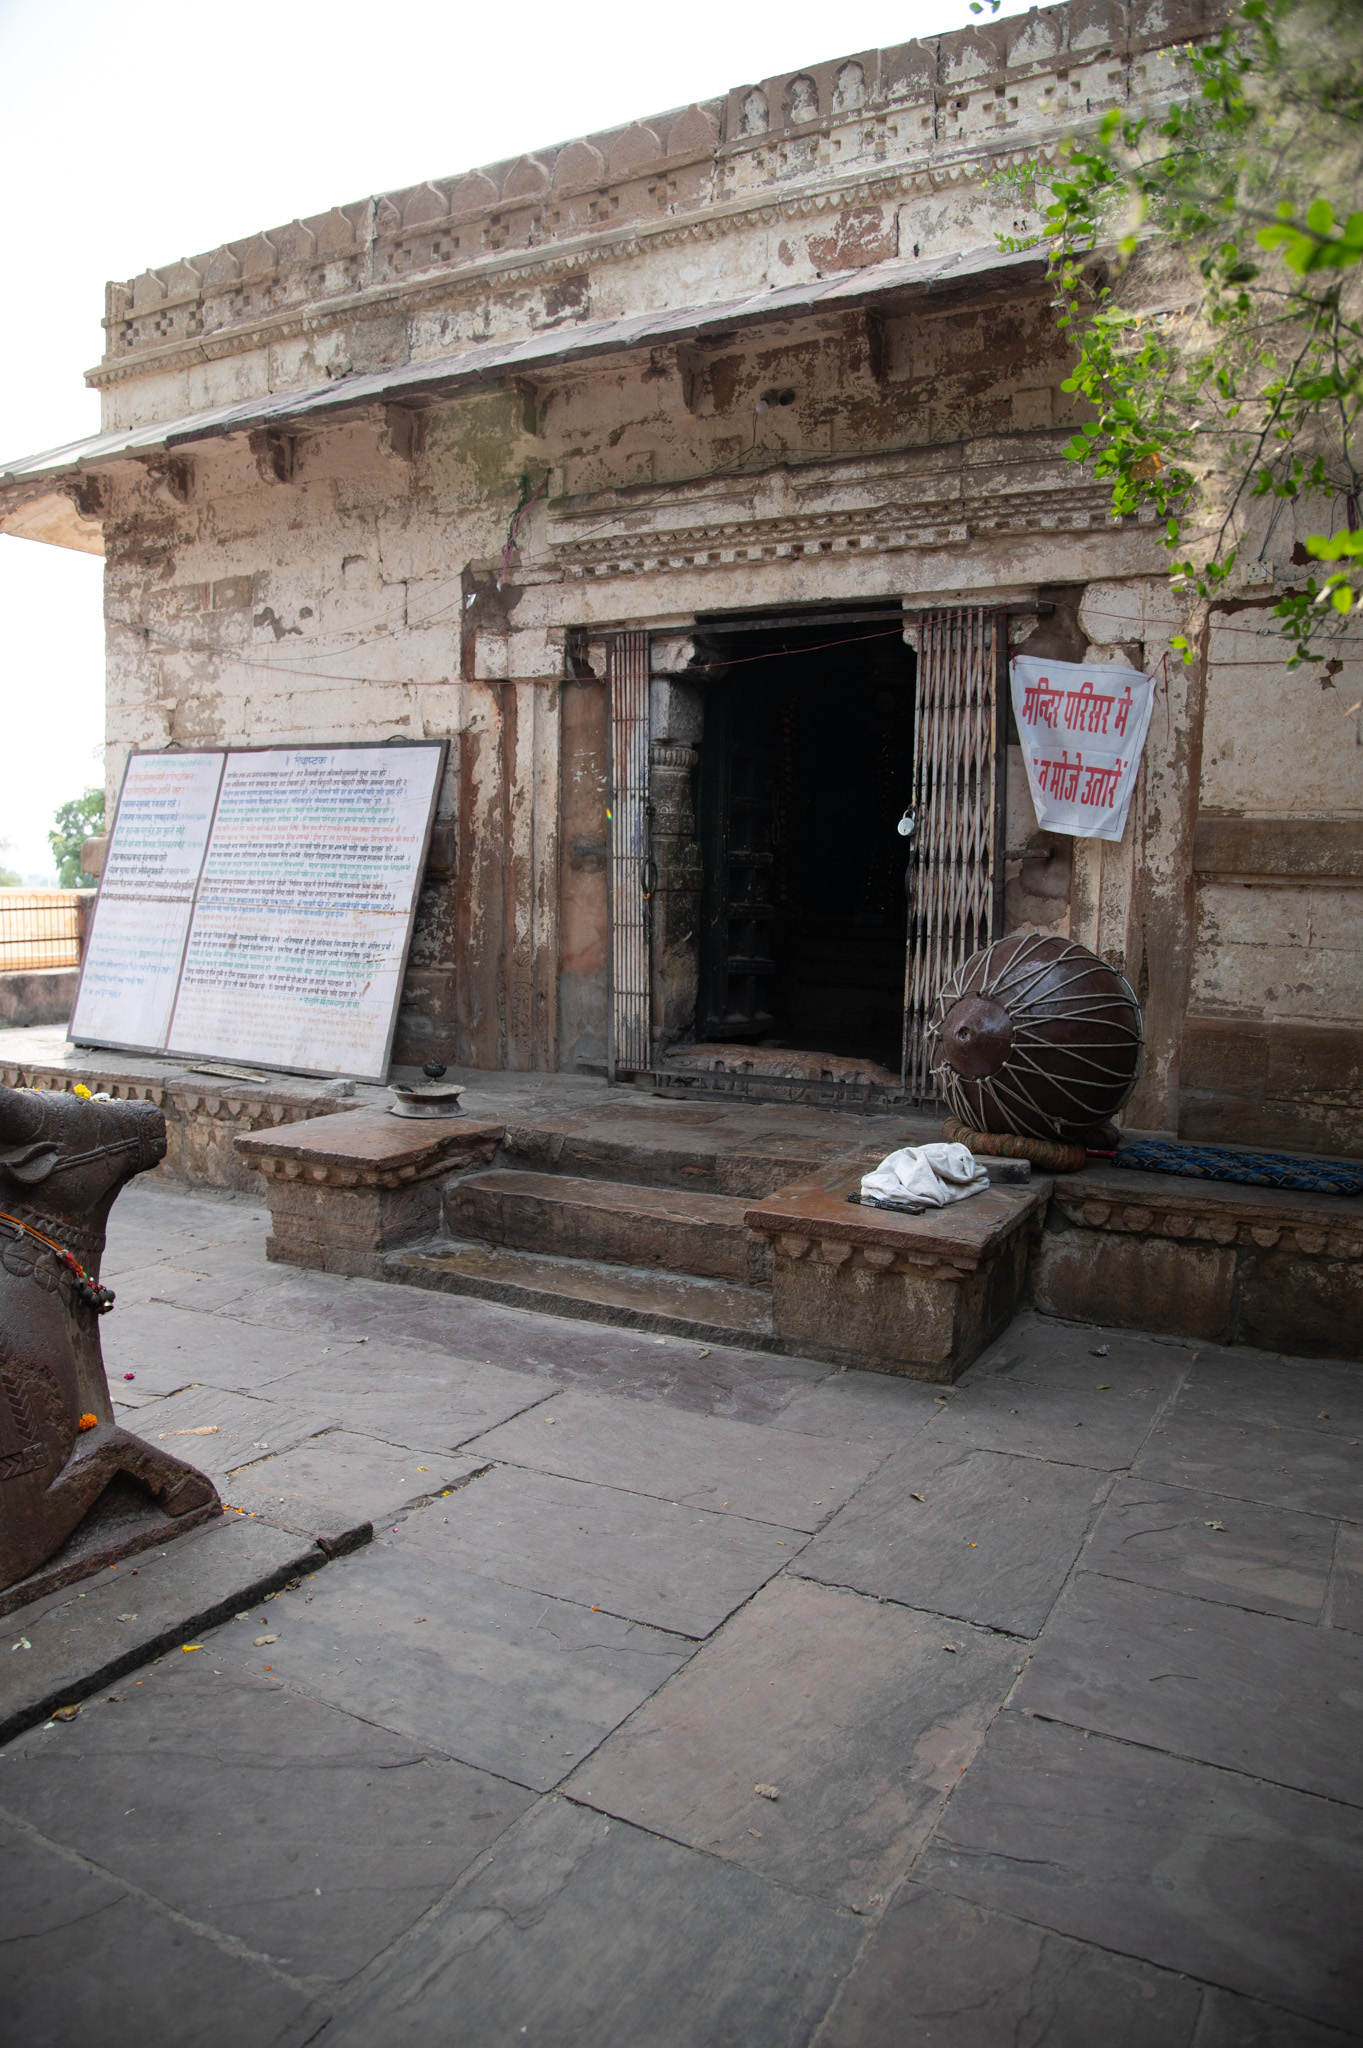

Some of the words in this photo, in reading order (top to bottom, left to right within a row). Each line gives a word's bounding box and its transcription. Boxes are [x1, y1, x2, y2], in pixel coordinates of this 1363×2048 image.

[1064, 681, 1115, 735] परिसर
[1050, 750, 1083, 802] मोजे
[1081, 757, 1128, 808] उतारें
